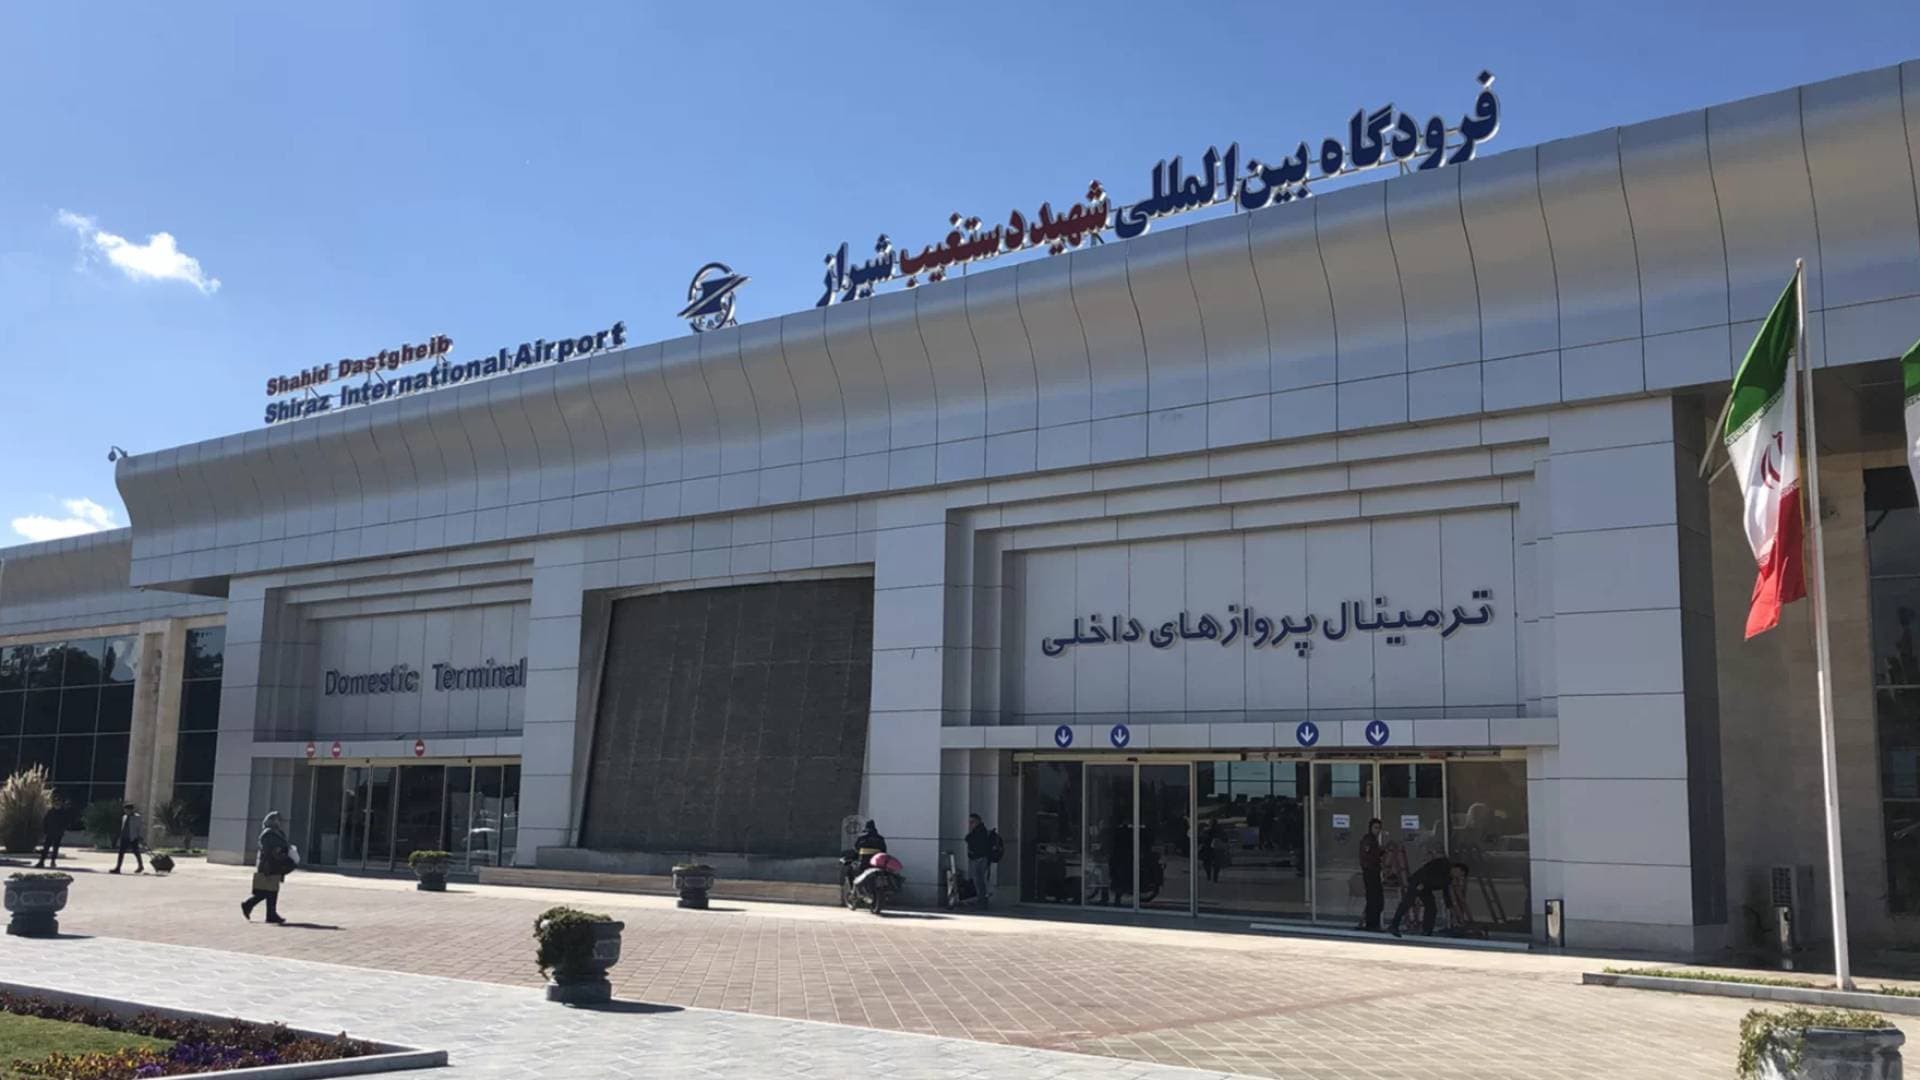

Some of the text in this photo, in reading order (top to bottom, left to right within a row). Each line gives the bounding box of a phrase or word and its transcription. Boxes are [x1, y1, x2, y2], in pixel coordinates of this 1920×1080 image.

[1319, 69, 1500, 176] فرودگاه
[899, 208, 1026, 288] دستغیب
[1029, 179, 1111, 256] شهید
[815, 233, 897, 308] شیراز
[264, 321, 627, 424] Shiraz International Airport
[266, 334, 453, 396] Shahid Dastgheib
[1041, 589, 1494, 658] ترمینال پروازهای داخلی
[324, 656, 529, 696] Domestic Terminal
